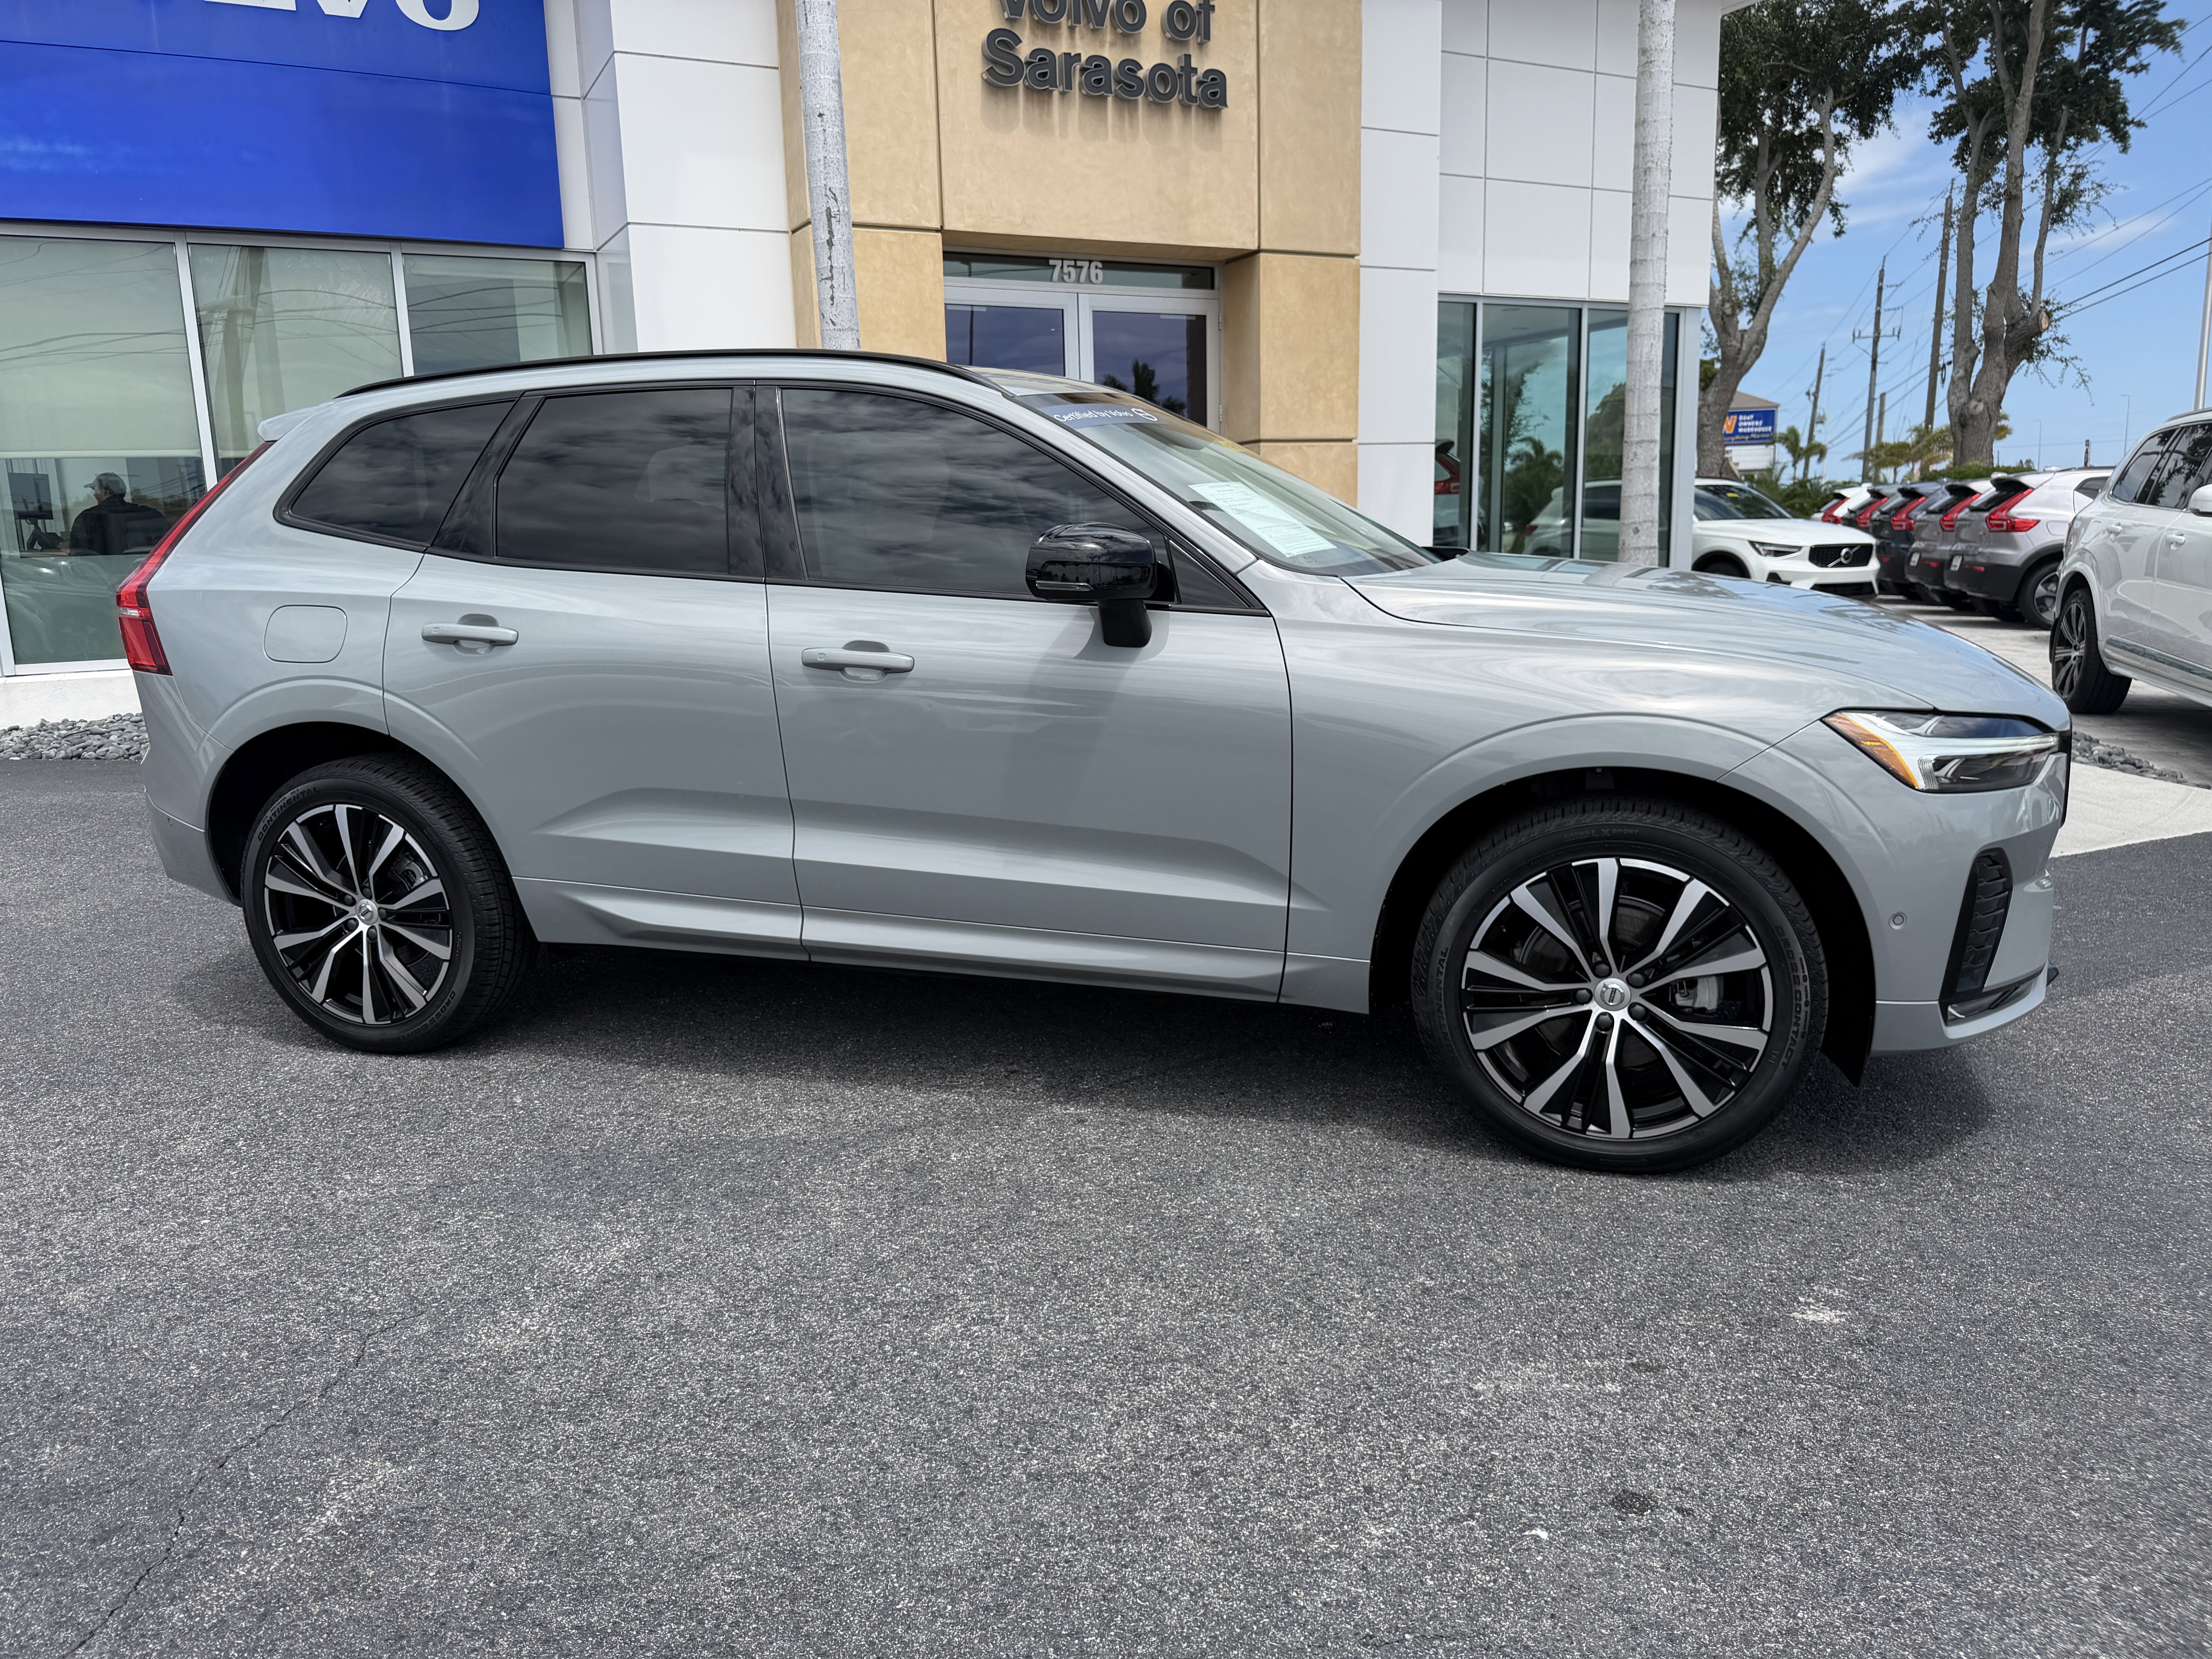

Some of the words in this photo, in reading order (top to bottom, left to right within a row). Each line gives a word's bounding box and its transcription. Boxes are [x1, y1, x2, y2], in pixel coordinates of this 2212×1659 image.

[1161, 0, 1215, 45] of
[981, 28, 1228, 109] Sarasota
[1048, 258, 1103, 284] 7576
[1053, 410, 1097, 422] Certified
[258, 787, 321, 842] CONTINENTAL
[1775, 926, 1800, 986] CROSS
[429, 991, 456, 1024] CROSS
[1434, 947, 1458, 1064] CONTINENTAL
[1782, 989, 1802, 1071] CONTACT
